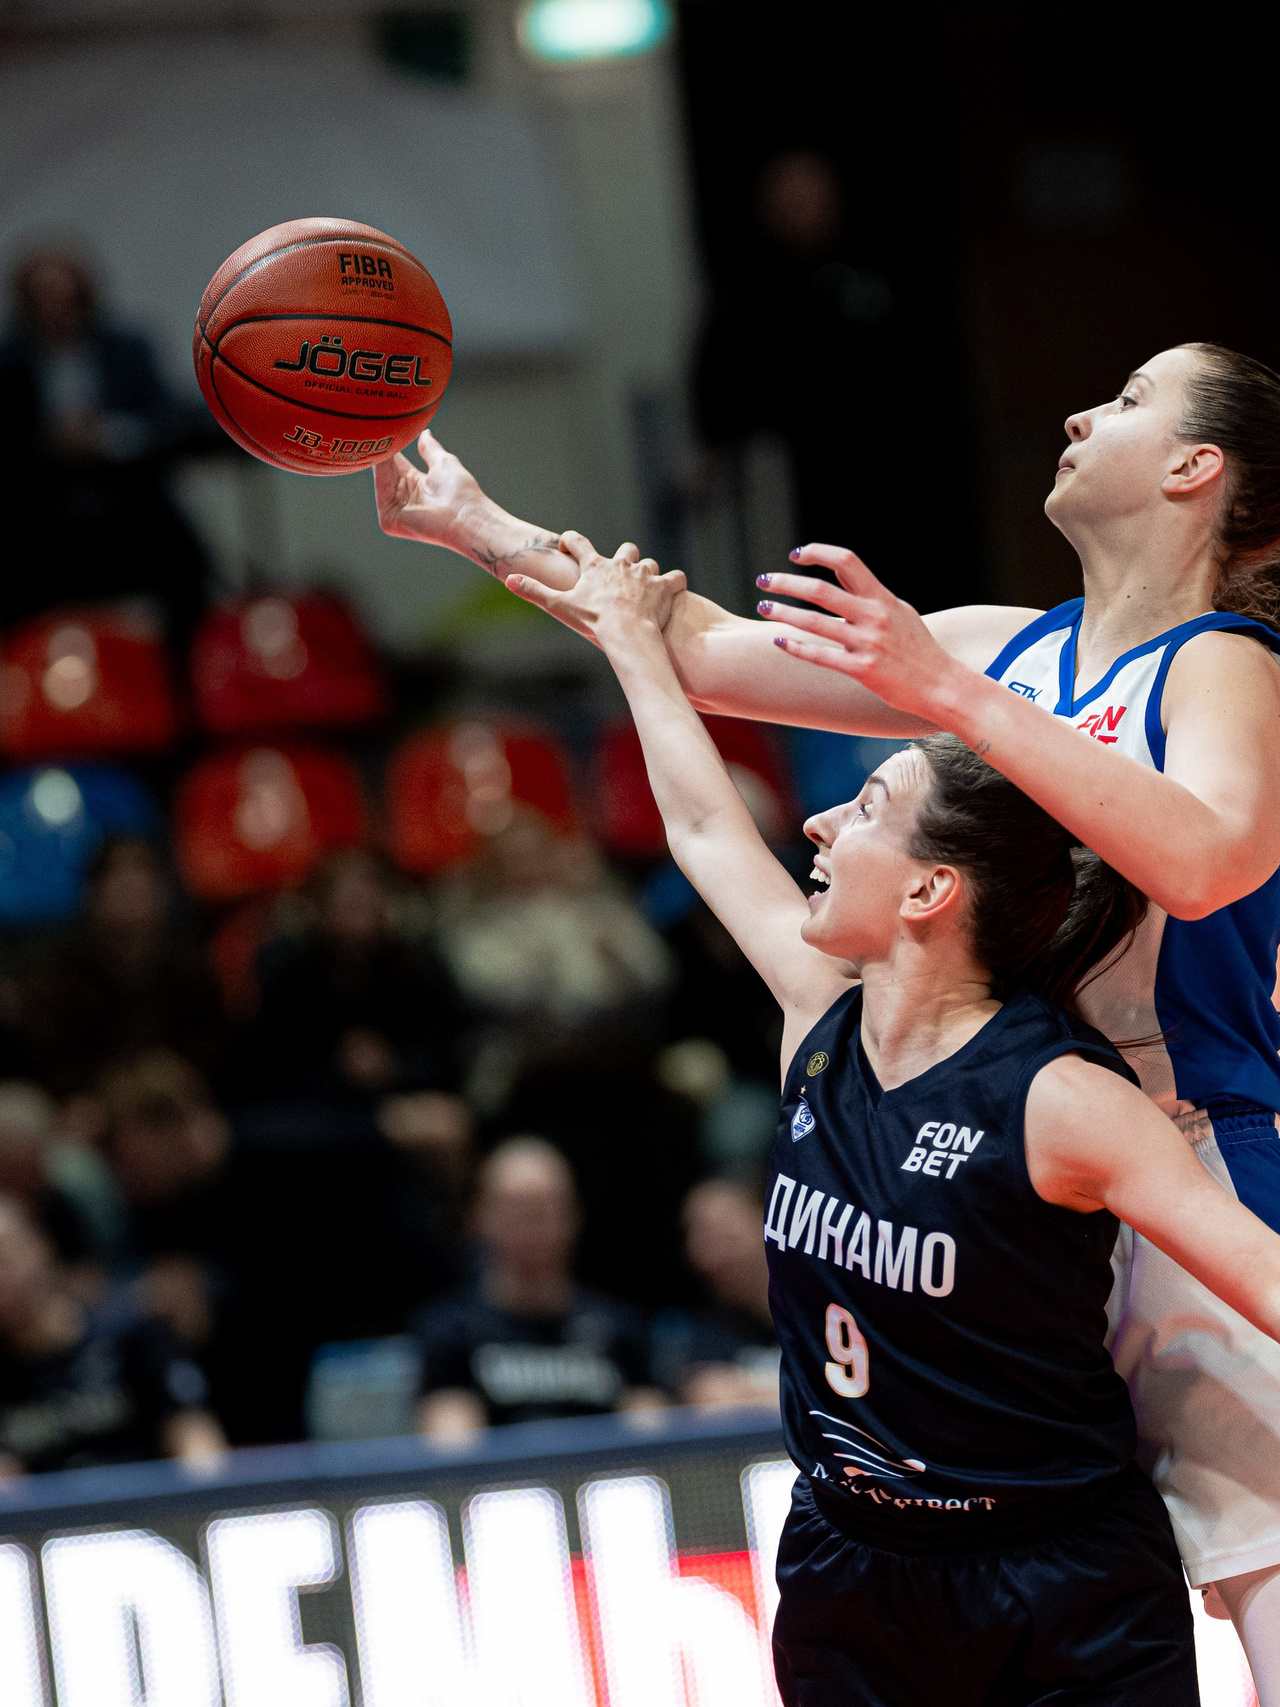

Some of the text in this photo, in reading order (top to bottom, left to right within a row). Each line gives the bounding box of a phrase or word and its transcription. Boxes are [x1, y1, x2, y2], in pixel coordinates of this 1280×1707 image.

[339, 253, 393, 279] FIBA
[341, 276, 394, 291] APPROVED
[273, 335, 433, 387] JÖGEL
[304, 380, 409, 399] OFFICIAL GAME BALL
[283, 425, 394, 454] JB-1000
[915, 1121, 985, 1153] FON
[901, 1147, 969, 1179] BET
[764, 1173, 956, 1297] ДИНАМО
[825, 1303, 870, 1398] 9
